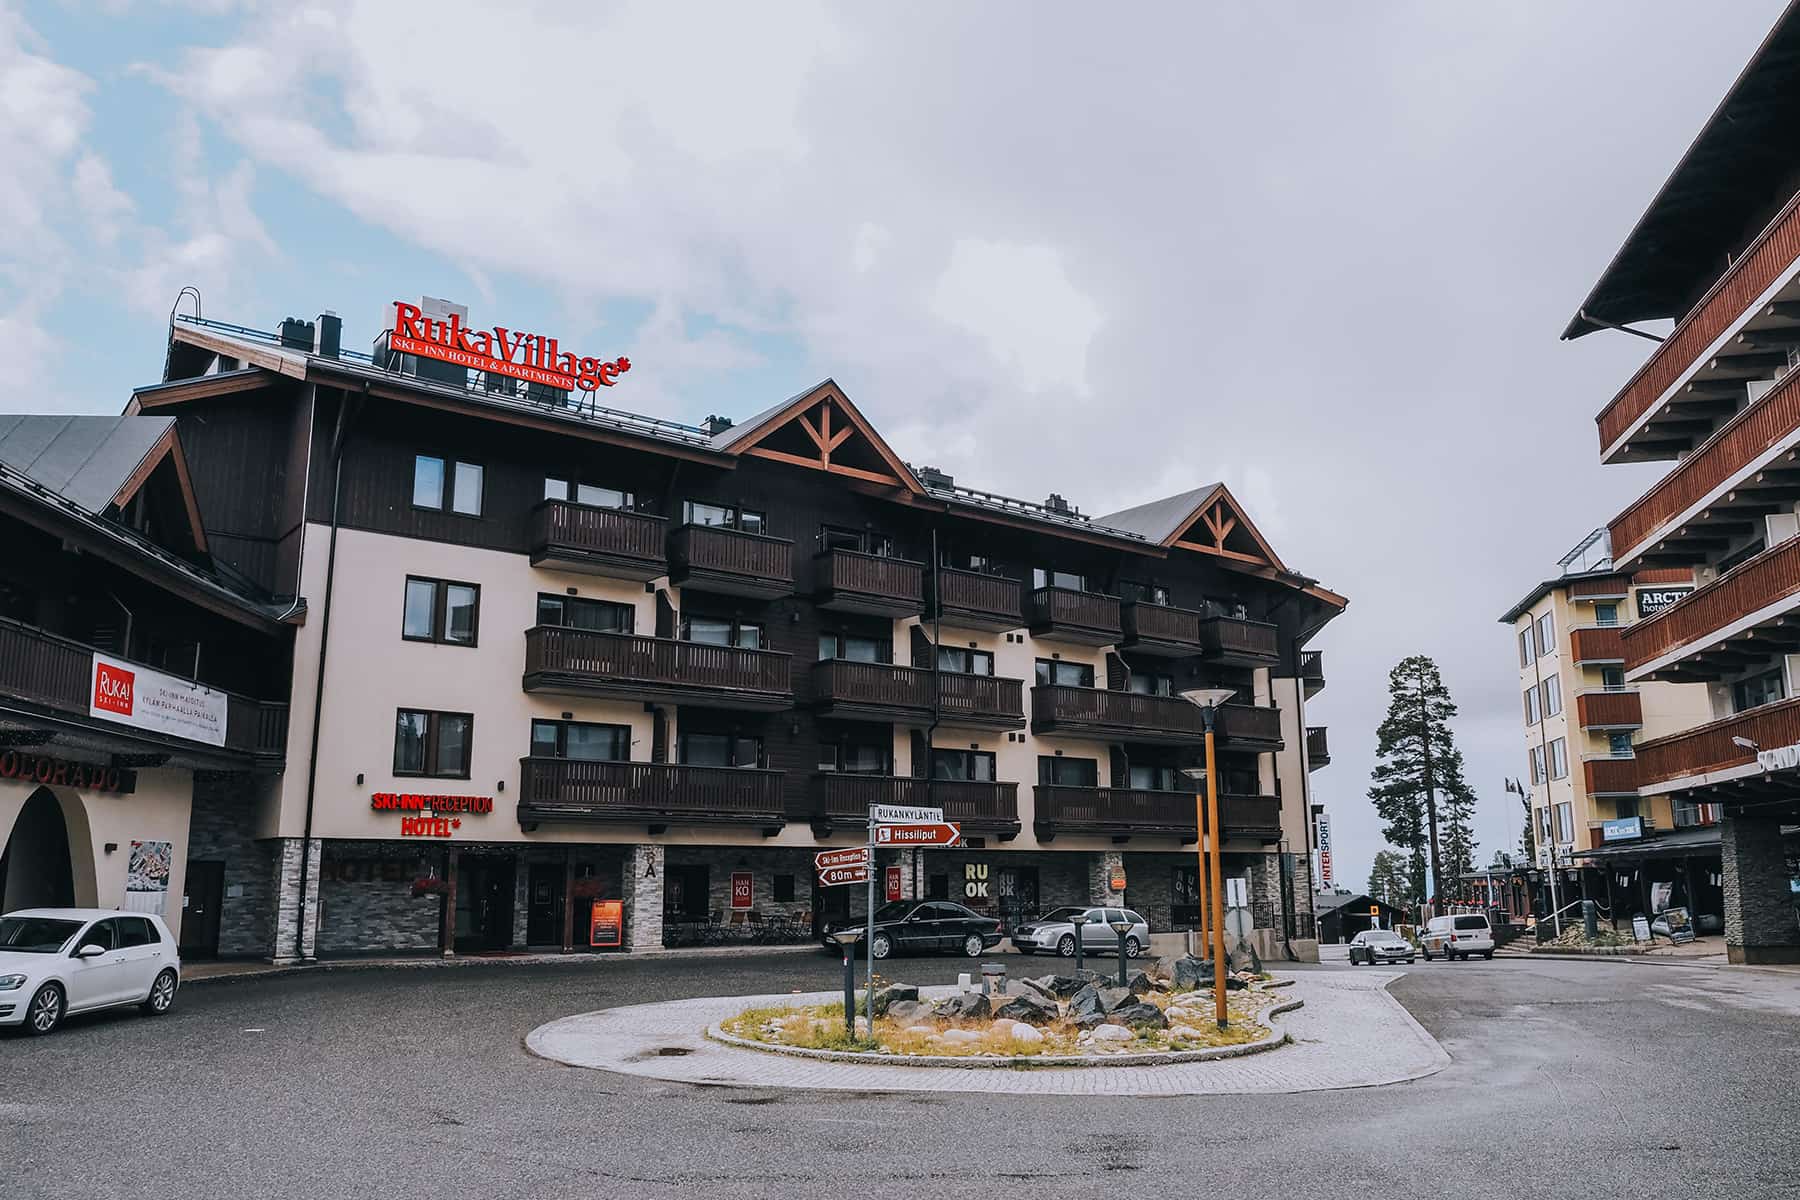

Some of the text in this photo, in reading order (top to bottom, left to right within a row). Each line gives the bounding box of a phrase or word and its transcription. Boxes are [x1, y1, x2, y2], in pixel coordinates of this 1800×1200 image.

[448, 351, 487, 368] HOTEL
[489, 360, 499, 370] &
[500, 364, 573, 388] APARTMENTS
[100, 671, 131, 701] RUKA!
[372, 792, 493, 813] SKI-INN RECEPTION
[401, 816, 452, 838] HOTEL
[894, 829, 937, 841] Hissiliput
[839, 852, 861, 863] Reception
[1319, 820, 1331, 881] INTERSPORT
[830, 870, 852, 881] 80m
[965, 863, 988, 880] RU
[735, 886, 749, 897] KO
[965, 882, 989, 898] OK
